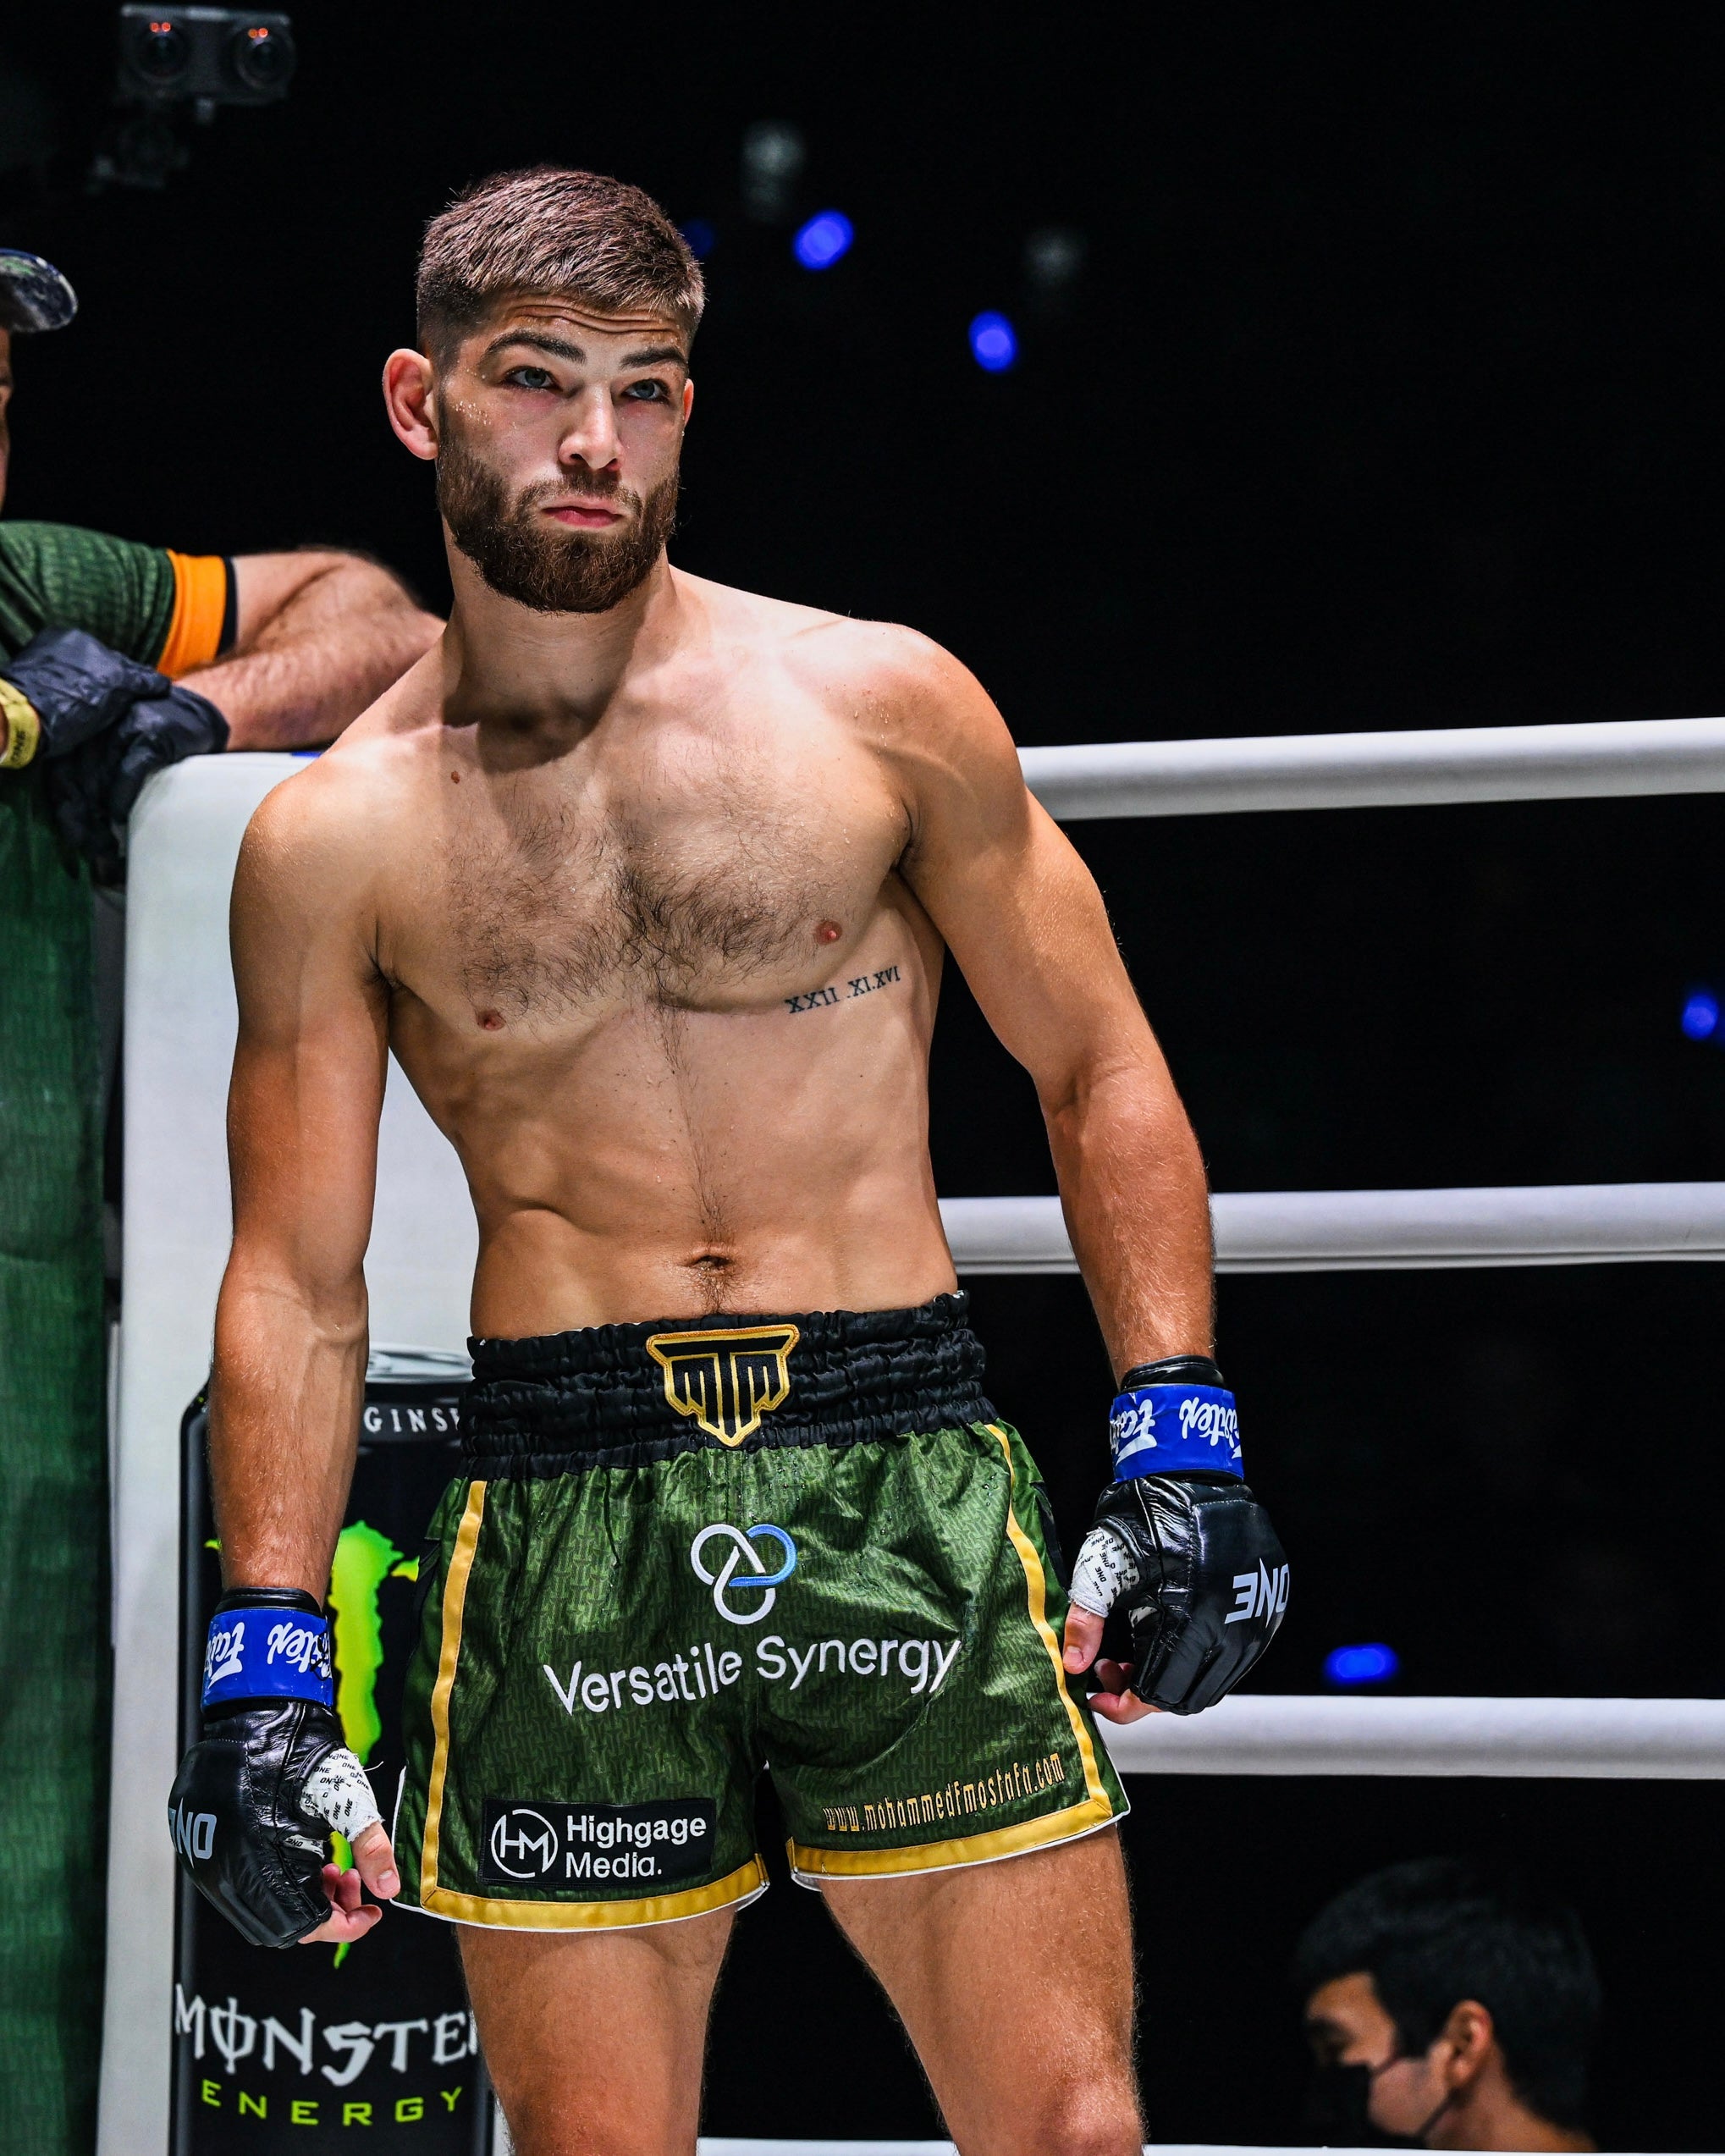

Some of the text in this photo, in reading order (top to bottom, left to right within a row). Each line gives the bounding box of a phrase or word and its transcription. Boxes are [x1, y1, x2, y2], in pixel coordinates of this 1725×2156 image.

[1095, 1566, 1107, 1583] ONE
[1224, 1558, 1290, 1629] ONE
[543, 1635, 962, 1717] Versatile Synergy
[341, 1762, 356, 1771] ONE
[356, 1779, 370, 1790] ONE
[333, 1801, 341, 1820] ONE
[344, 1798, 353, 1817] ONE
[168, 1797, 218, 1869] ON
[566, 1815, 707, 1849] Highgage
[565, 1852, 663, 1878] Media.
[201, 2079, 463, 2127] ENERGY
